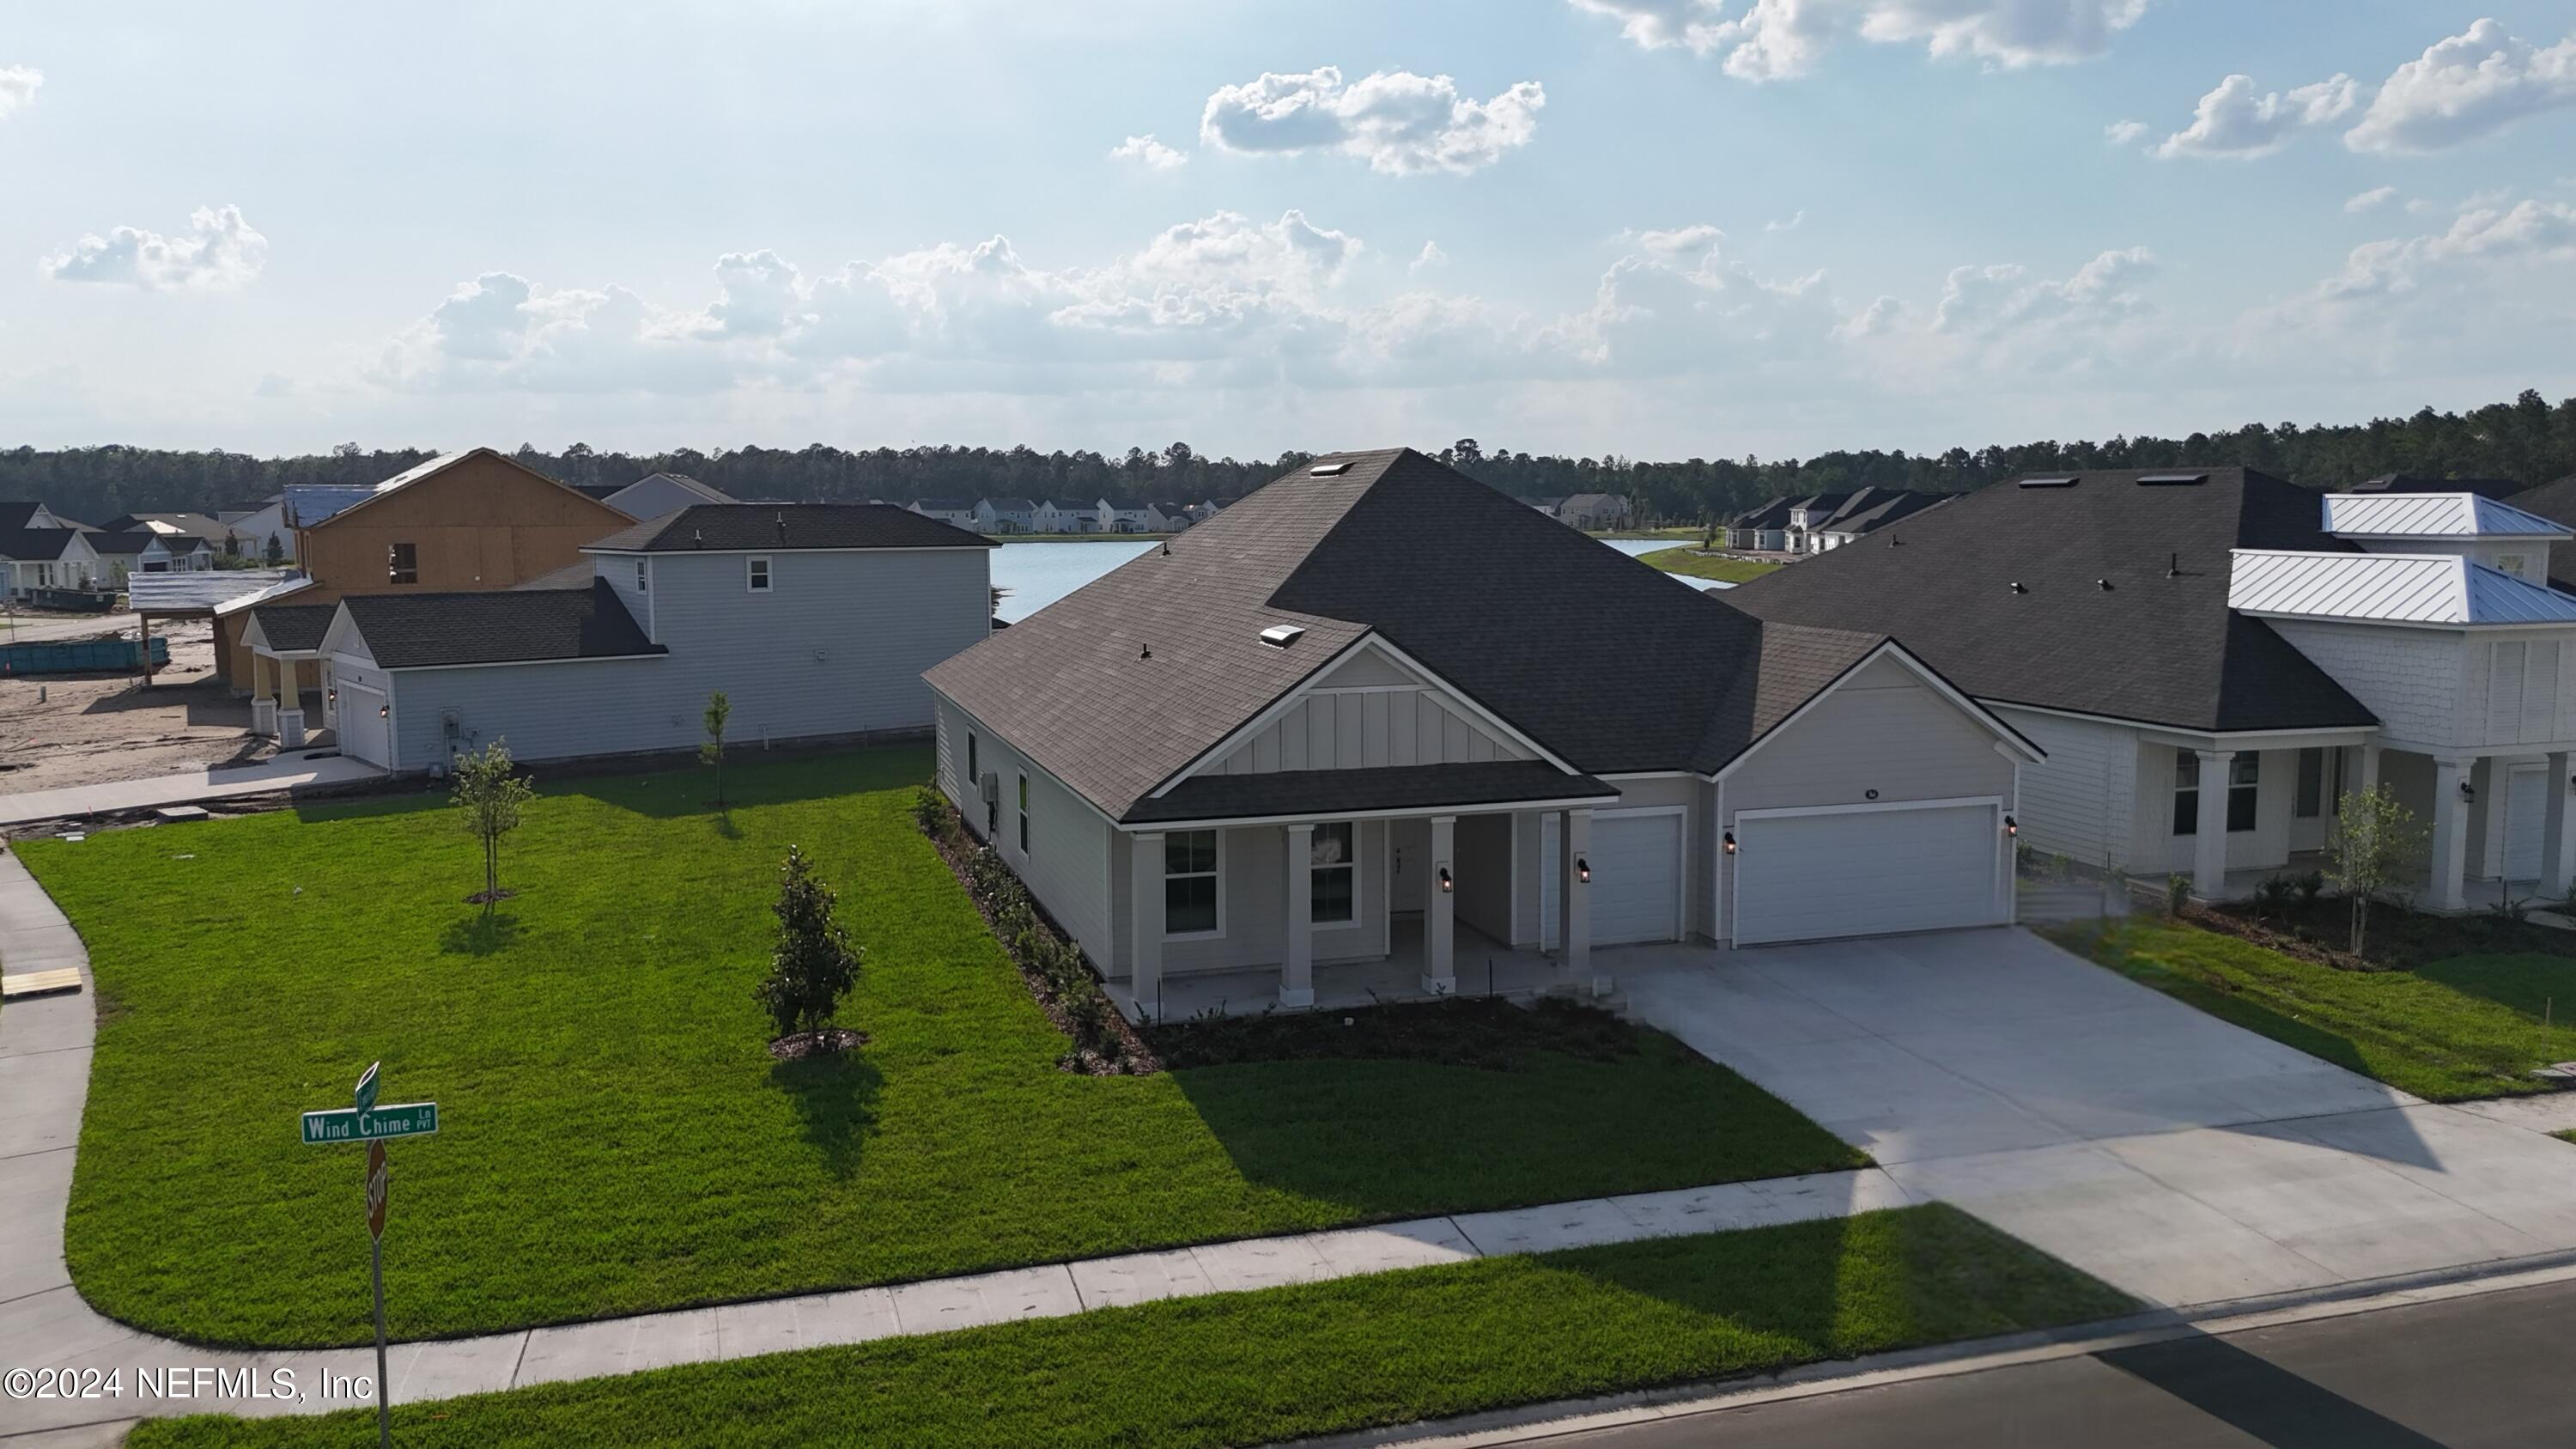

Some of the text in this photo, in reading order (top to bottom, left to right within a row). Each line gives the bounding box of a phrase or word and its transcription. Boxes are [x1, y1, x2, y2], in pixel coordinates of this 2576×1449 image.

[308, 1108, 431, 1139] Wind Chime Ln
[416, 1118, 431, 1129] PVT
[368, 1161, 386, 1219] STOP
